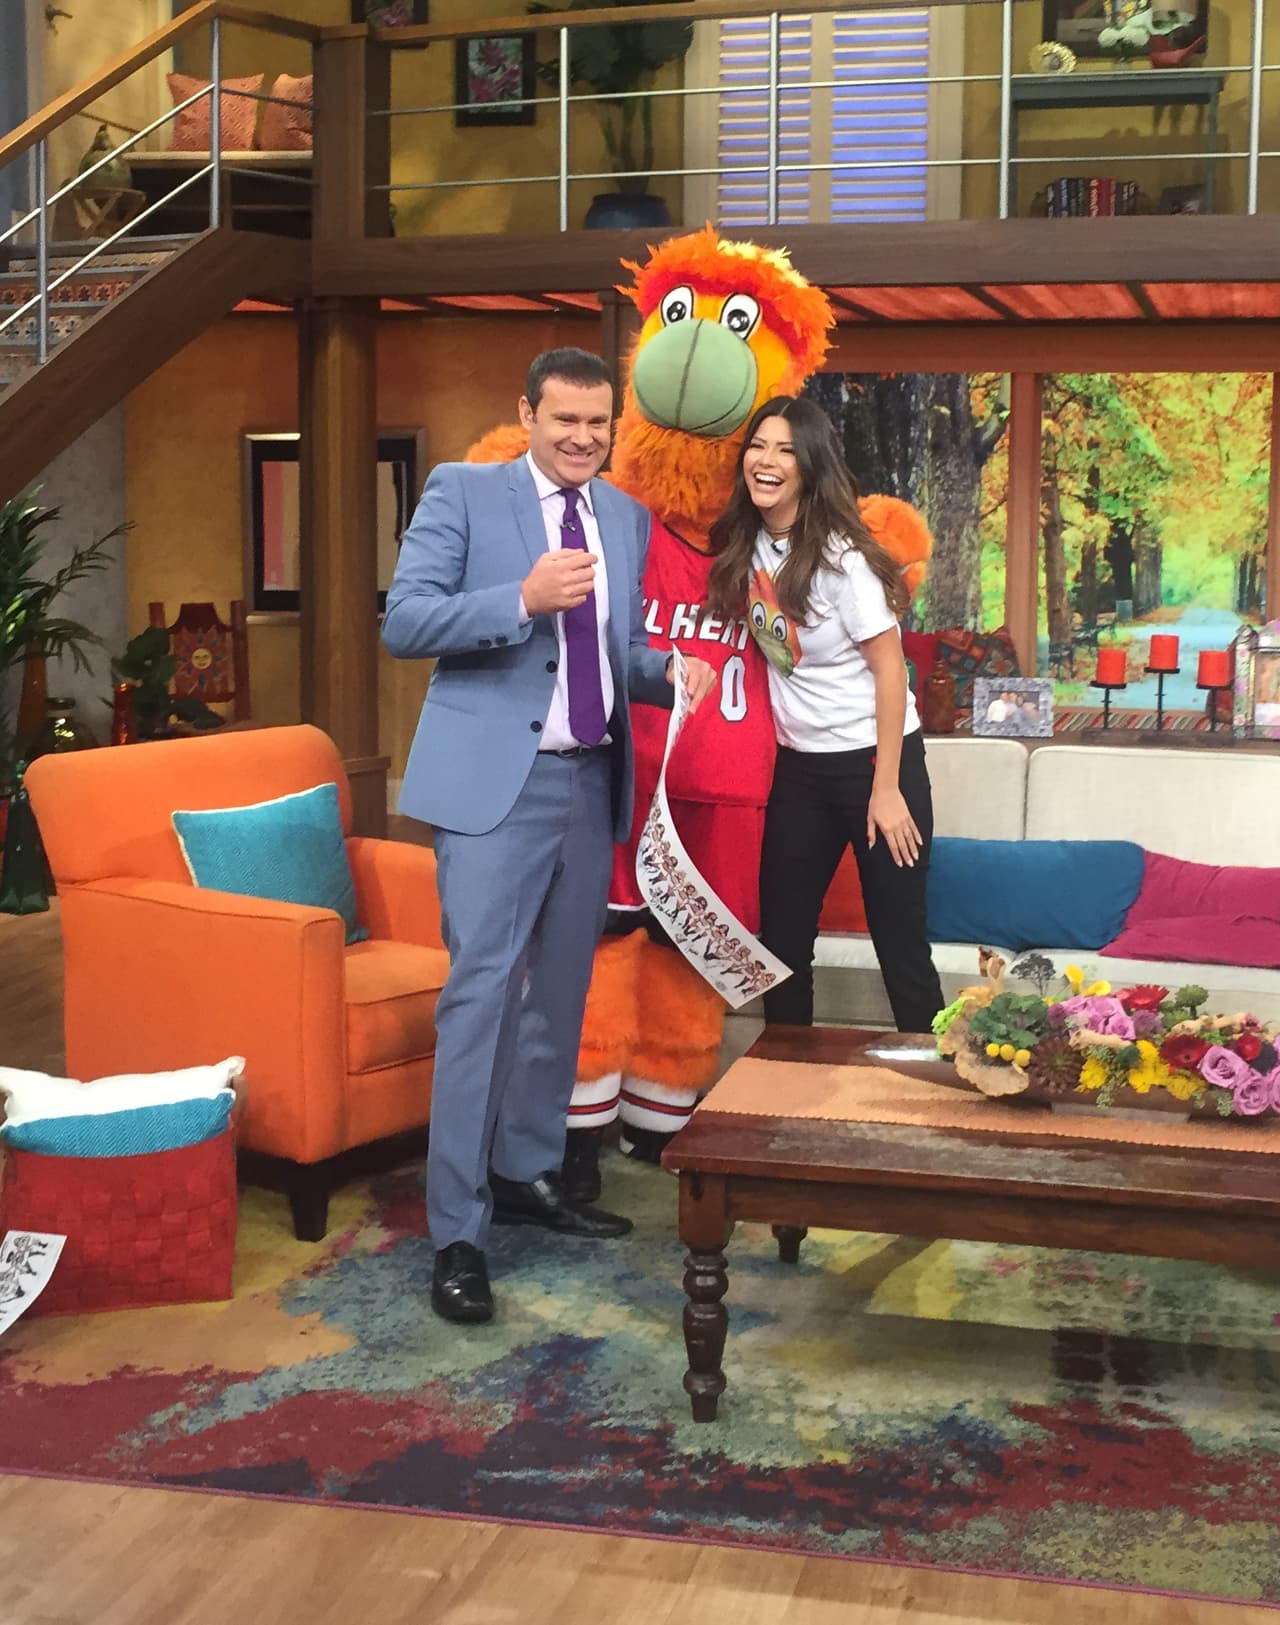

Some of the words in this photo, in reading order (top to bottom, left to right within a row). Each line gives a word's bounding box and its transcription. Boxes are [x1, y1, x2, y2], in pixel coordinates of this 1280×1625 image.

[642, 598, 664, 635] L
[668, 602, 749, 651] HEAT
[719, 654, 748, 722] 0
